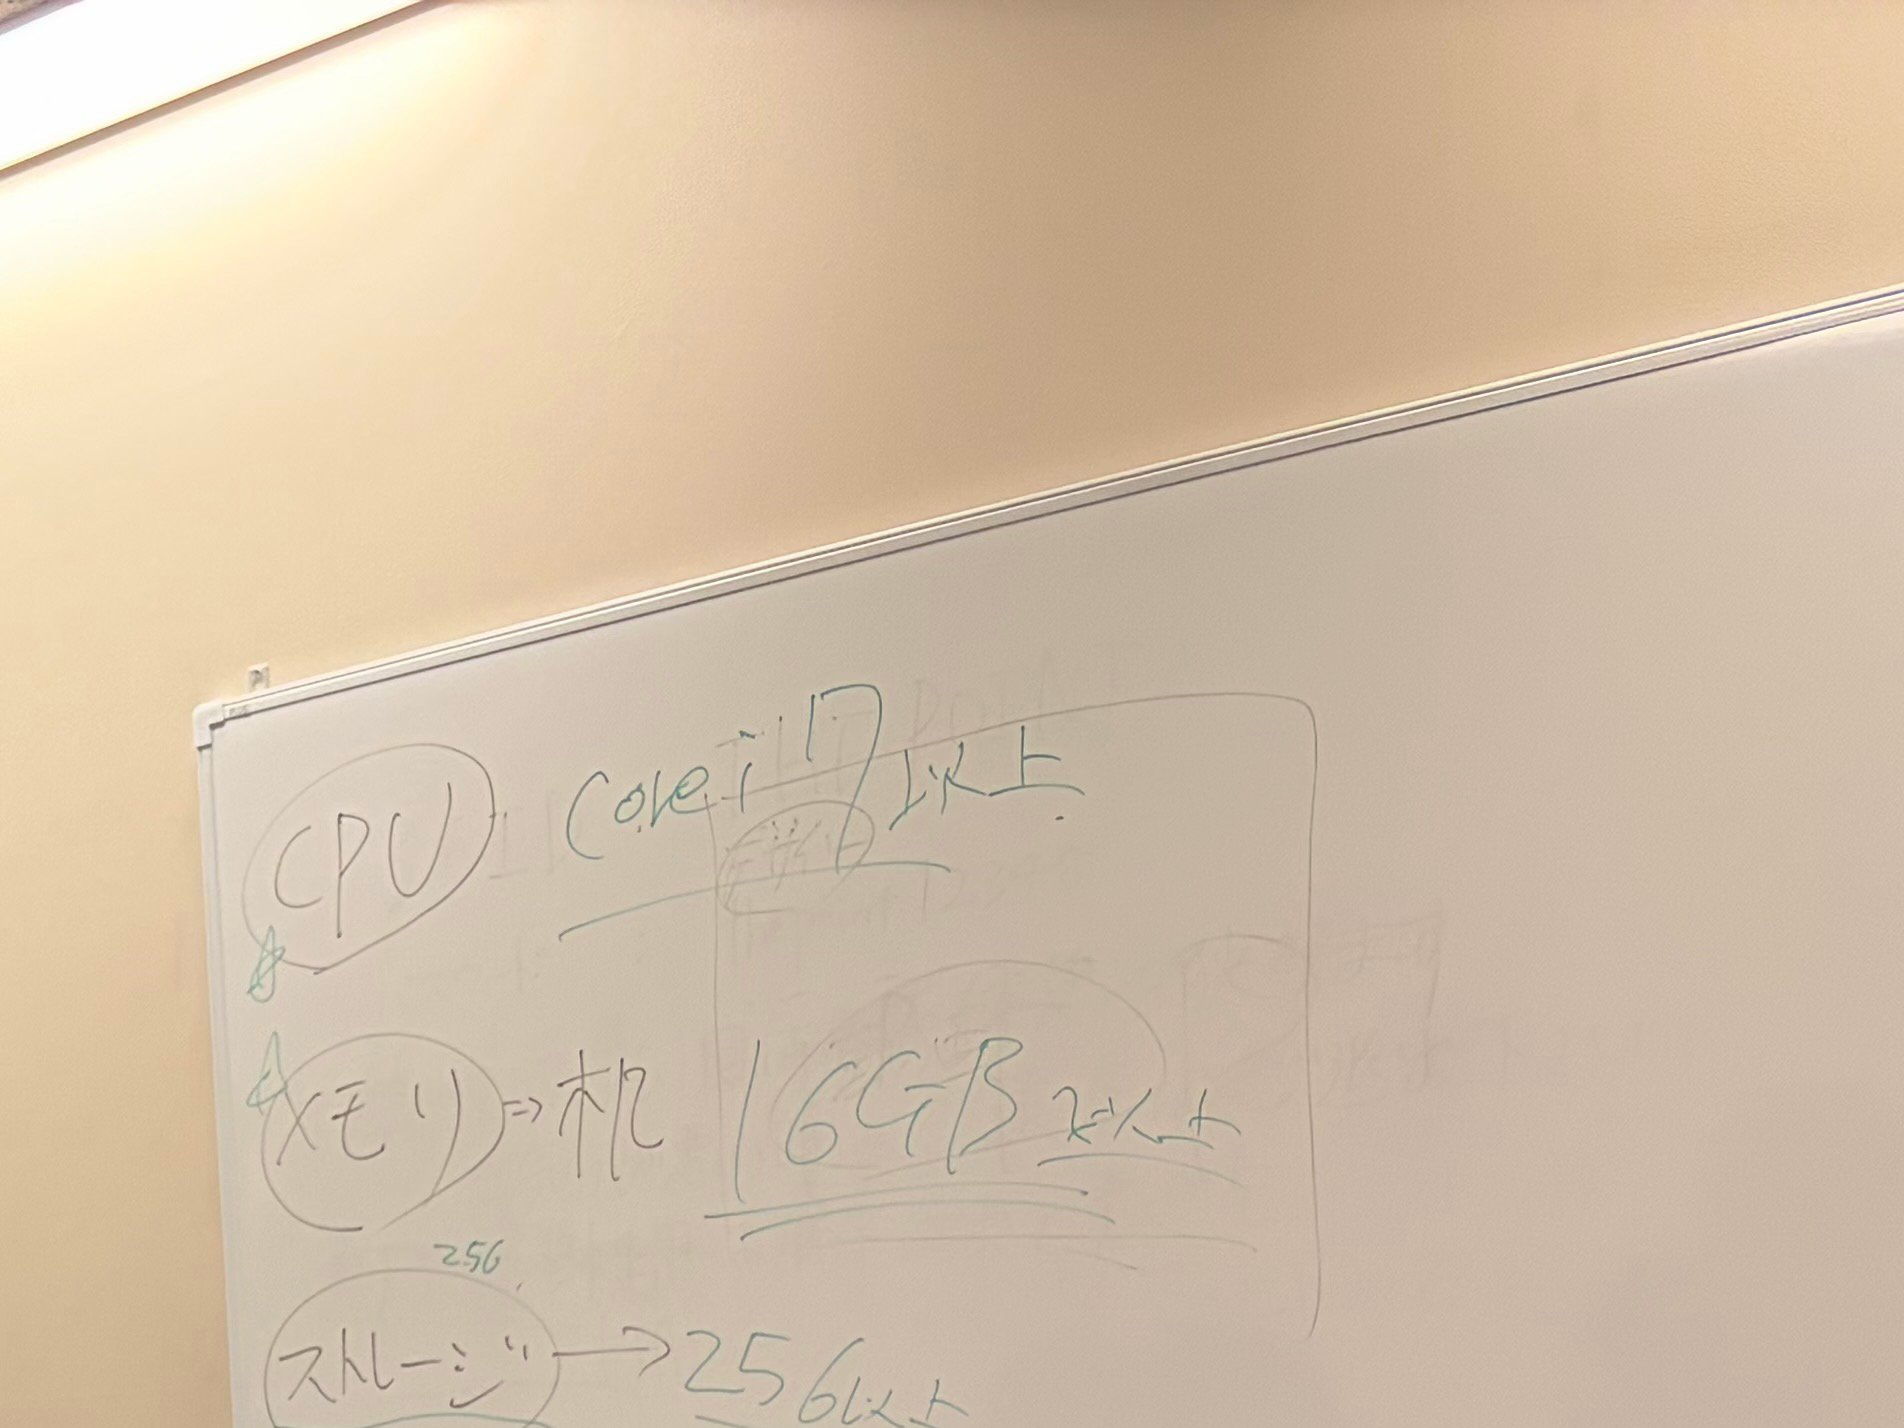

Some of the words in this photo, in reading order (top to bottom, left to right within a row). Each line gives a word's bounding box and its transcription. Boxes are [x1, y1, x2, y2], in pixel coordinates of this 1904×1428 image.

[274, 781, 453, 939] CPU
[276, 1068, 462, 1198] メモリ
[433, 1238, 505, 1274] 256
[277, 1328, 530, 1409] ストレージ
